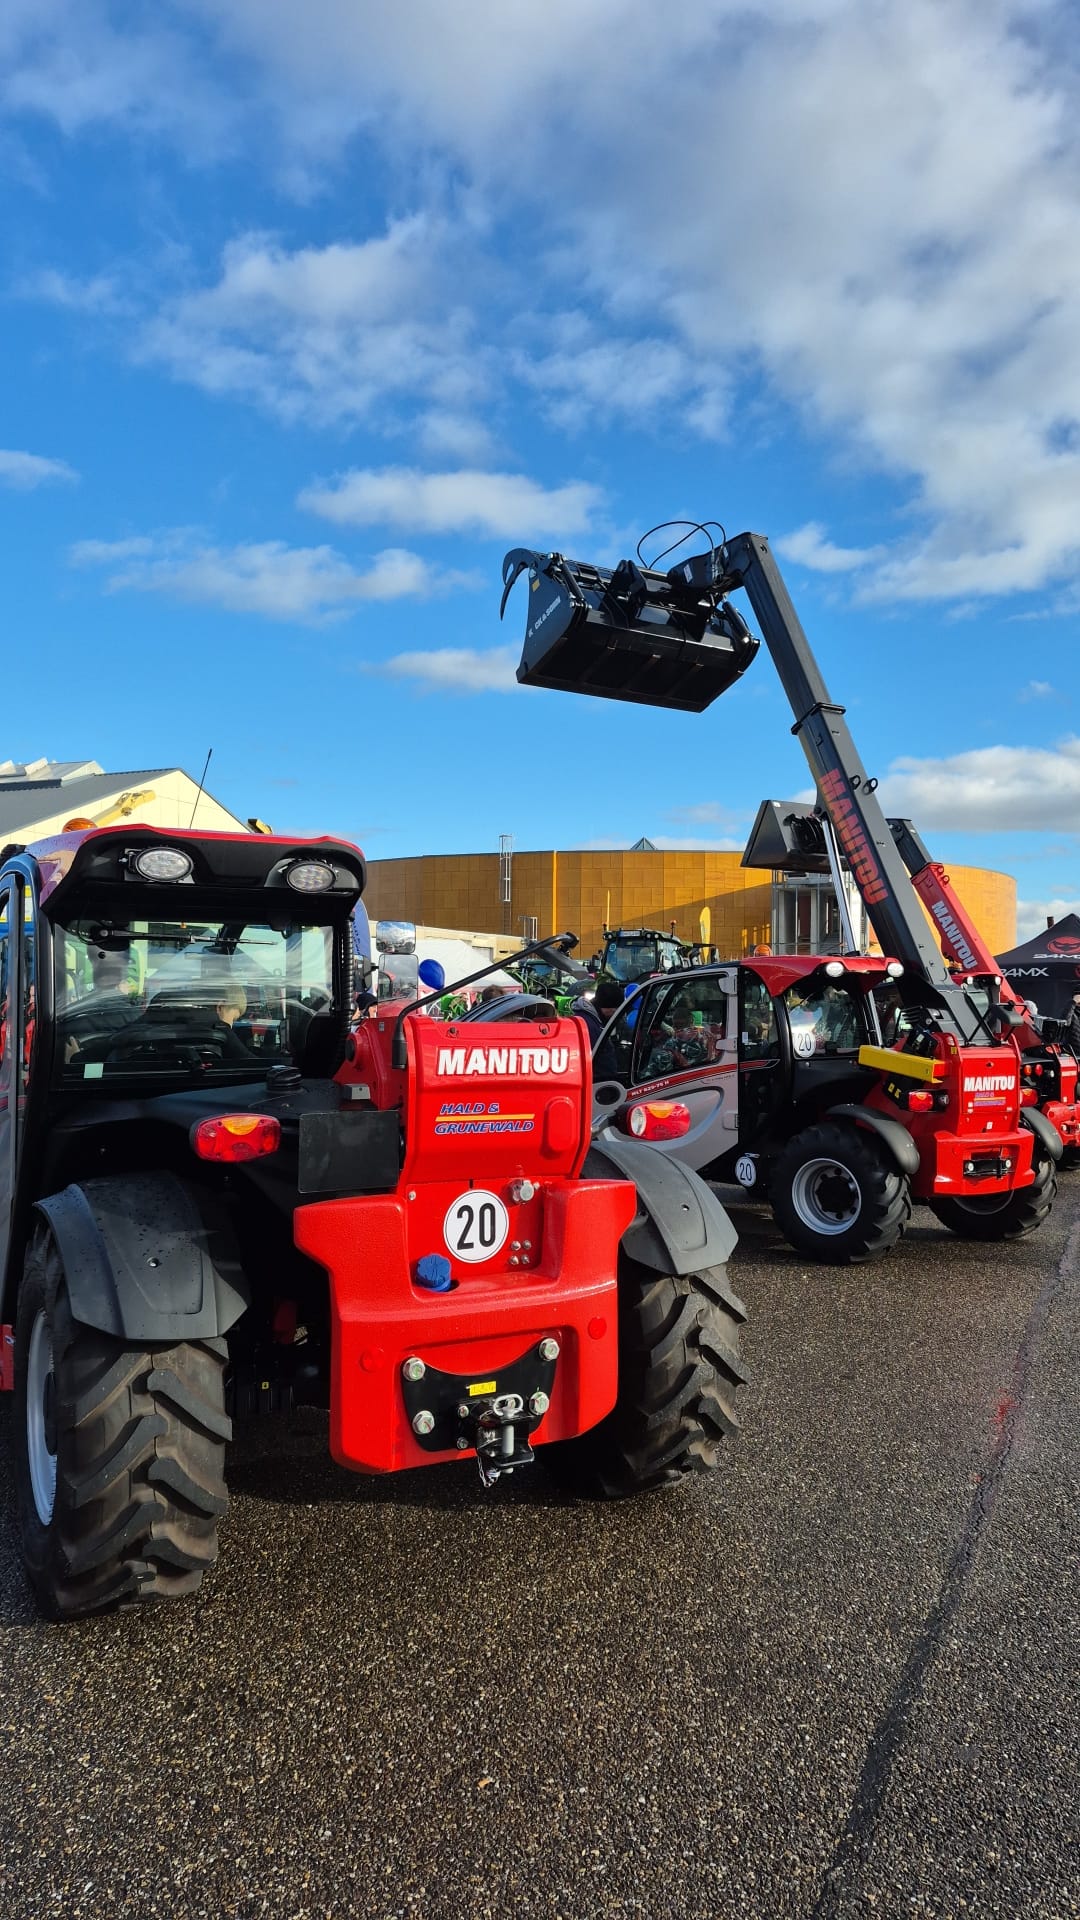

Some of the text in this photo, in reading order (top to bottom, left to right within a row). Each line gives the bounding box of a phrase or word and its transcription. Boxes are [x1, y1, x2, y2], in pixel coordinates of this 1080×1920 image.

[819, 768, 888, 904] MANITOU
[931, 901, 978, 969] MANITOU
[798, 1033, 813, 1052] 20
[438, 1048, 568, 1075] MANITOU
[963, 1075, 1015, 1091] MANITOU
[440, 1103, 499, 1115] HALD &
[434, 1120, 534, 1135] GRUNEWALD
[739, 1163, 753, 1182] 20
[457, 1203, 496, 1250] 20
